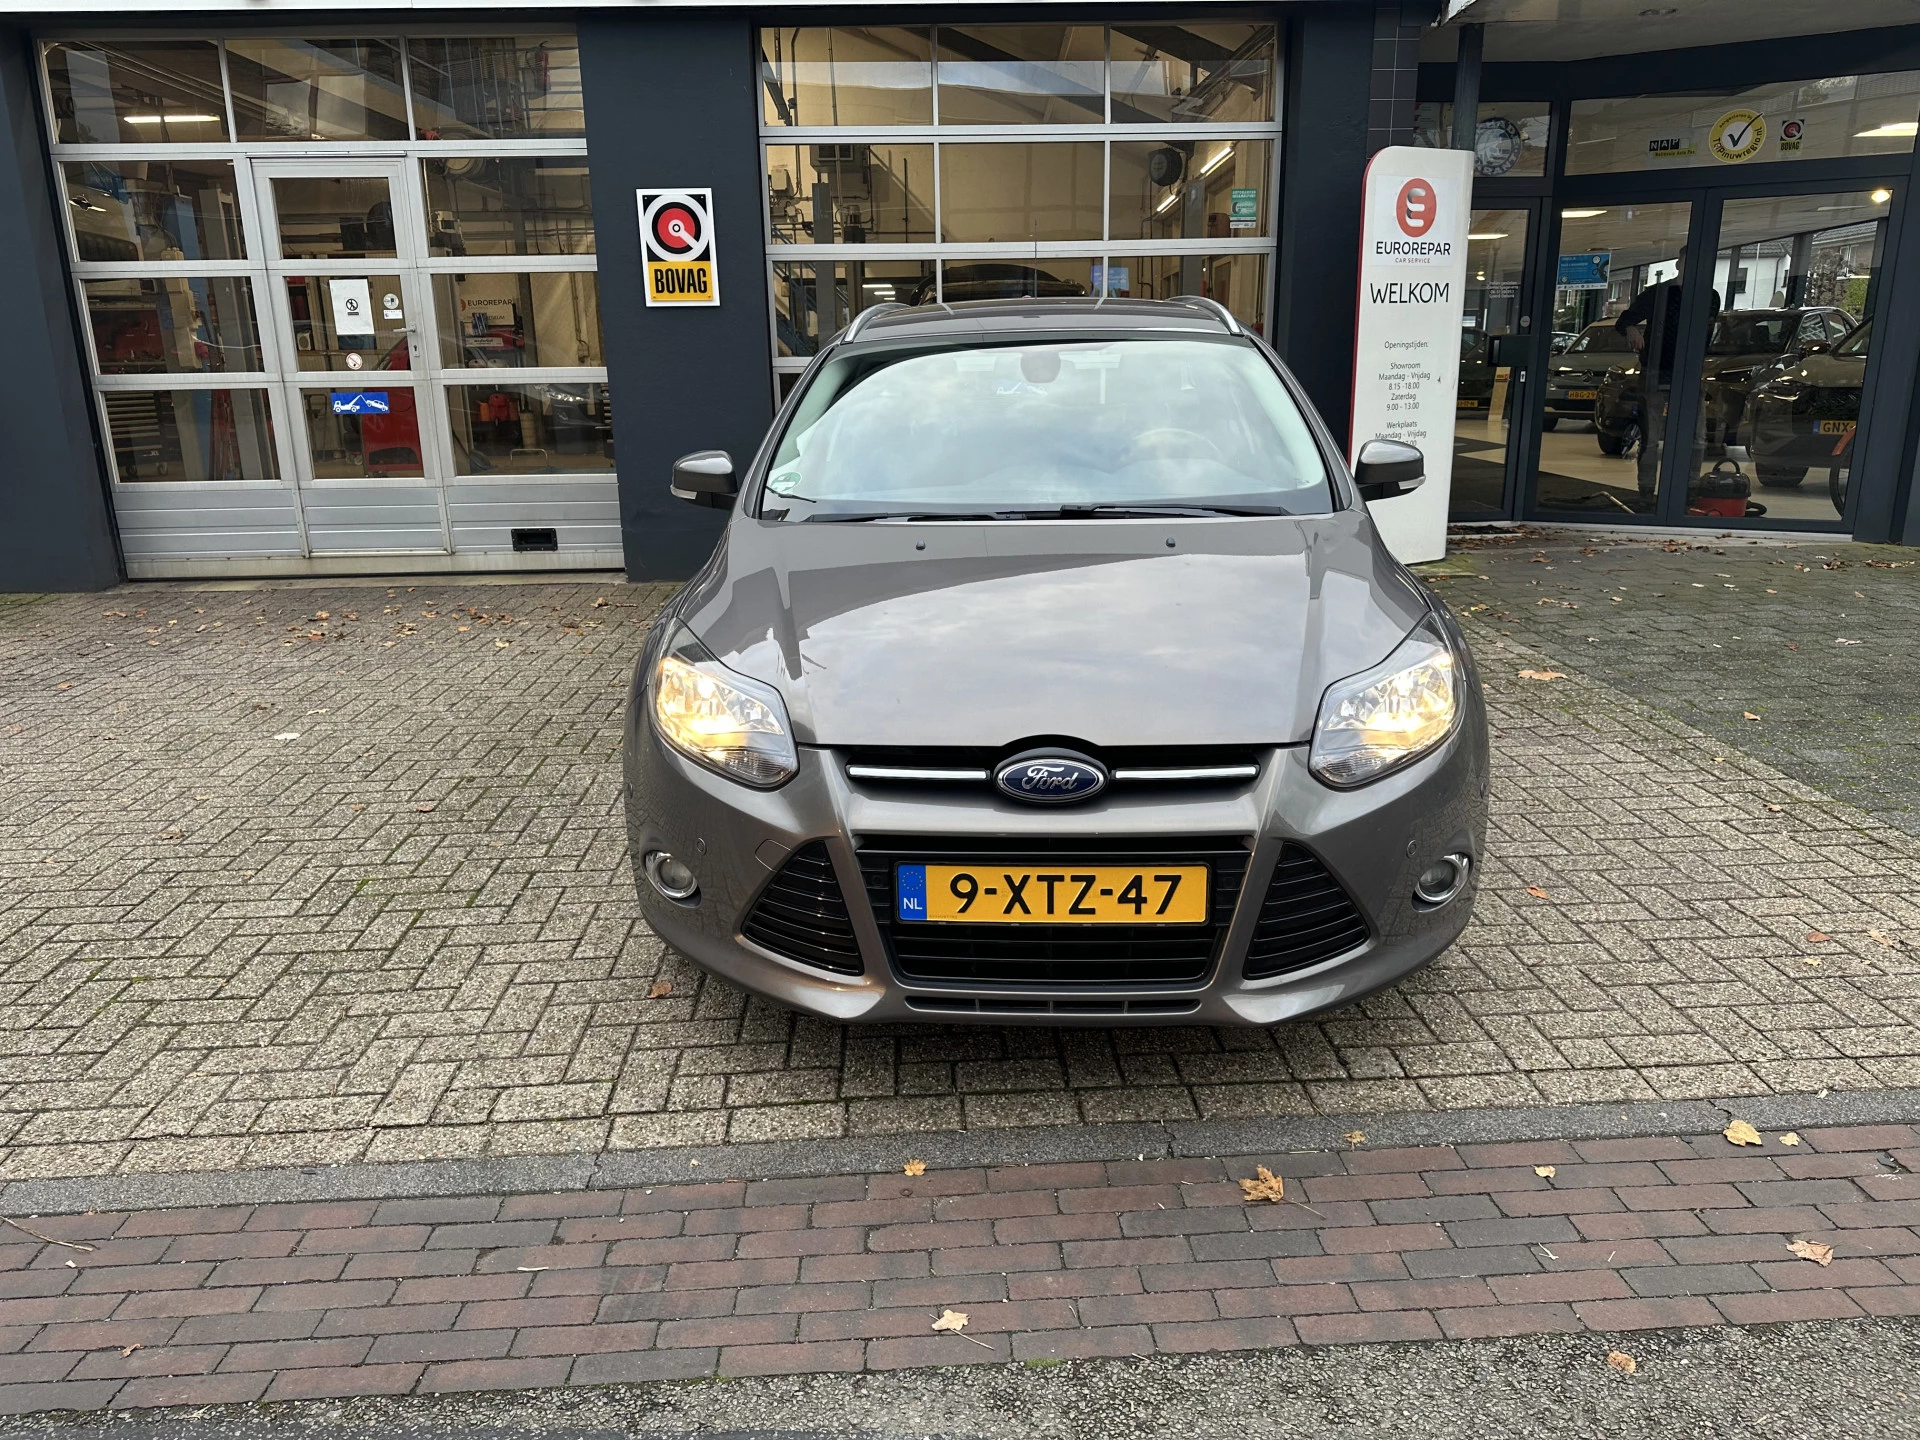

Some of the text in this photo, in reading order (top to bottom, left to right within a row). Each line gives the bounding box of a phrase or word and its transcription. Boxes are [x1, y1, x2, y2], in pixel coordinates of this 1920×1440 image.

[1651, 138, 1679, 150] NAP
[1781, 142, 1800, 151] BOVAG
[1376, 241, 1451, 255] EUROREPAR
[654, 267, 708, 294] BOVAG
[1370, 282, 1449, 304] WELKOM
[467, 298, 513, 306] EUROREPAR
[1384, 340, 1429, 350] Openingstijden:
[1390, 362, 1421, 370] Showroom
[1378, 373, 1406, 381] Maandag
[1411, 371, 1431, 381] Vrijdag
[1388, 382, 1401, 391] 8.15
[1391, 392, 1417, 401] Zaterdag
[1386, 403, 1399, 411] 9.00
[1404, 402, 1420, 410] 13.00
[1386, 421, 1418, 430] Werkplaats
[1375, 432, 1402, 440] Maandag
[1407, 429, 1427, 440] Vrijdag
[1021, 765, 1079, 790] Ford
[903, 873, 1182, 915] NL 9-XTZ-47
